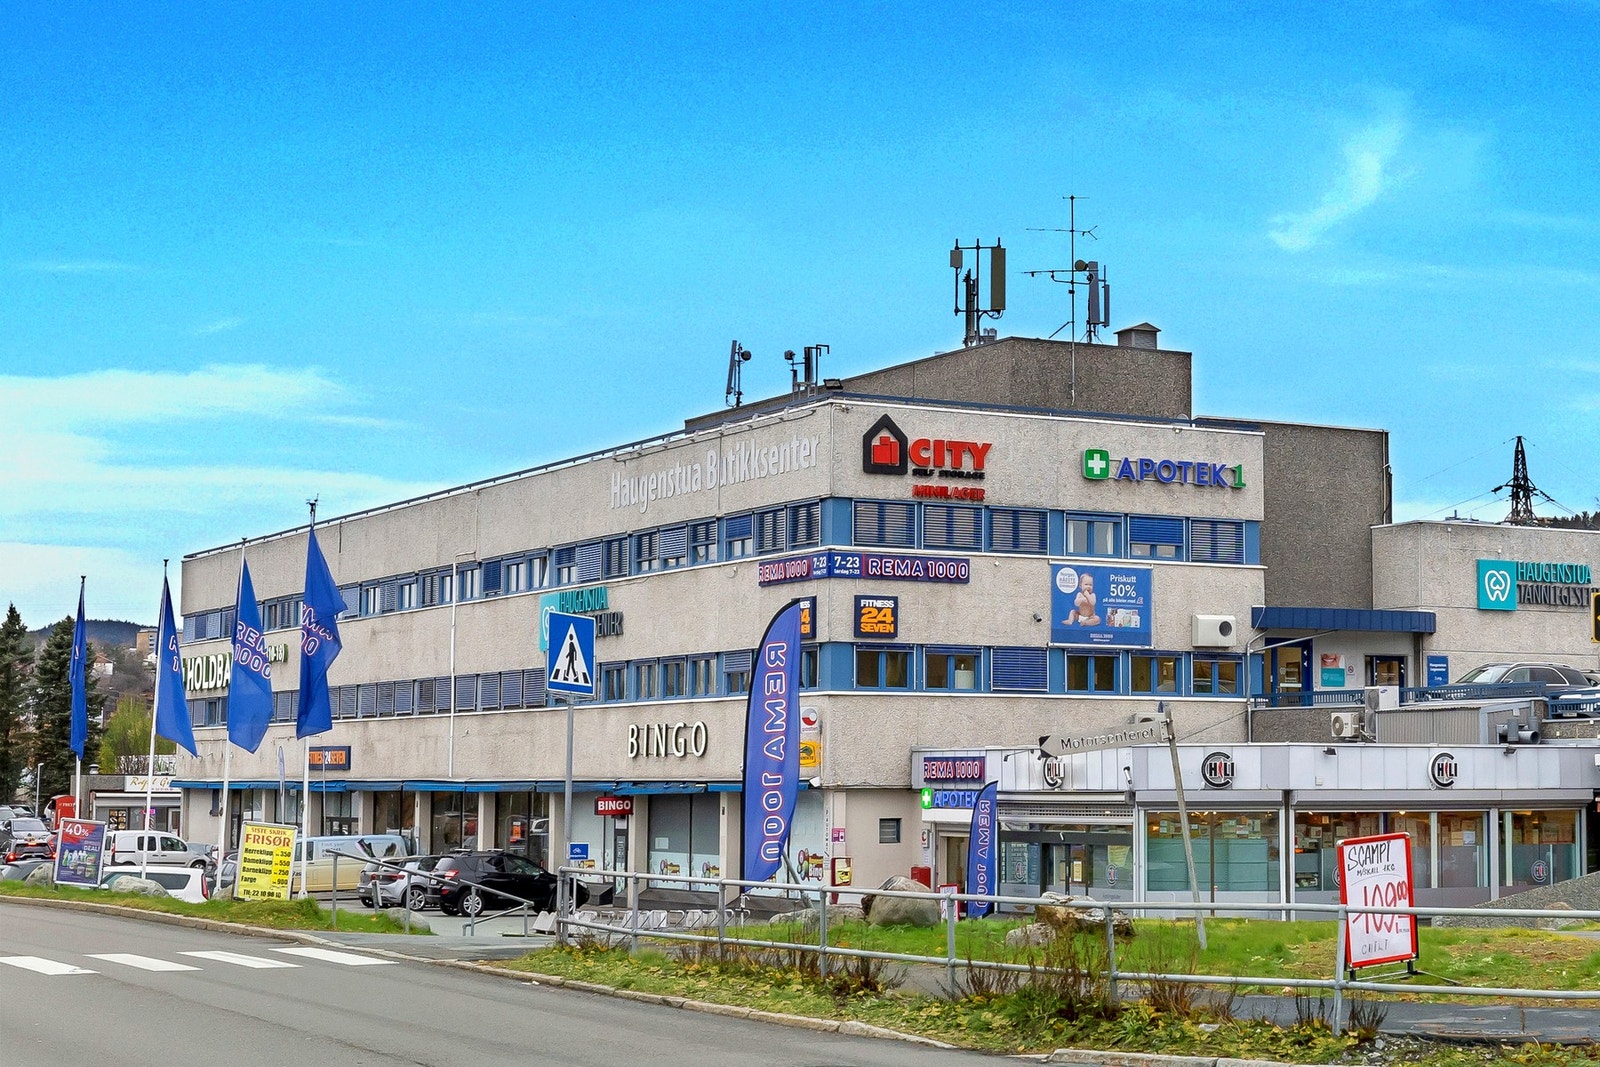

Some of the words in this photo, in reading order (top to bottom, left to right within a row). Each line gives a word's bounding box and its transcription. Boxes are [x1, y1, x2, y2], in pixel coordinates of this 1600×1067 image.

[909, 438, 992, 470] CITY
[611, 459, 702, 514] Haugenstua
[706, 435, 820, 490] Butikksenter
[912, 468, 935, 477] SELF
[938, 470, 985, 480] STORAGE
[1117, 457, 1228, 487] APOTEK
[912, 485, 985, 501] MINILAGER
[814, 556, 827, 568] 7-23
[834, 556, 860, 568] 7-23
[868, 558, 924, 577] REMA
[928, 560, 969, 579] 1000
[759, 561, 785, 582] REMA
[786, 559, 808, 577] 1000
[1110, 574, 1137, 583] Priskutt
[1517, 562, 1592, 584] HAUGENSTUA
[1110, 584, 1137, 597] 50%
[559, 586, 608, 614] HAUGENSTUA
[860, 600, 894, 608] FITNESS
[860, 607, 894, 624] 24
[860, 623, 894, 633] SEVEN
[234, 643, 272, 680] 1000
[187, 652, 232, 691] HOLDBA
[628, 721, 708, 758] BINGO
[1060, 727, 1155, 750] Motorsenteret
[924, 761, 953, 778] REMA
[955, 761, 980, 778] 1000
[597, 801, 631, 810] BINGO
[934, 791, 979, 808] APOTEK
[245, 833, 291, 847] FRISØR
[269, 828, 287, 836] SKRIK
[243, 856, 273, 865] Dameklipp
[244, 847, 273, 856] Herreklipp
[280, 850, 291, 858] 350
[1347, 840, 1392, 871] SCAMPI
[242, 866, 272, 875] Barneklipp
[241, 875, 257, 883] Farge
